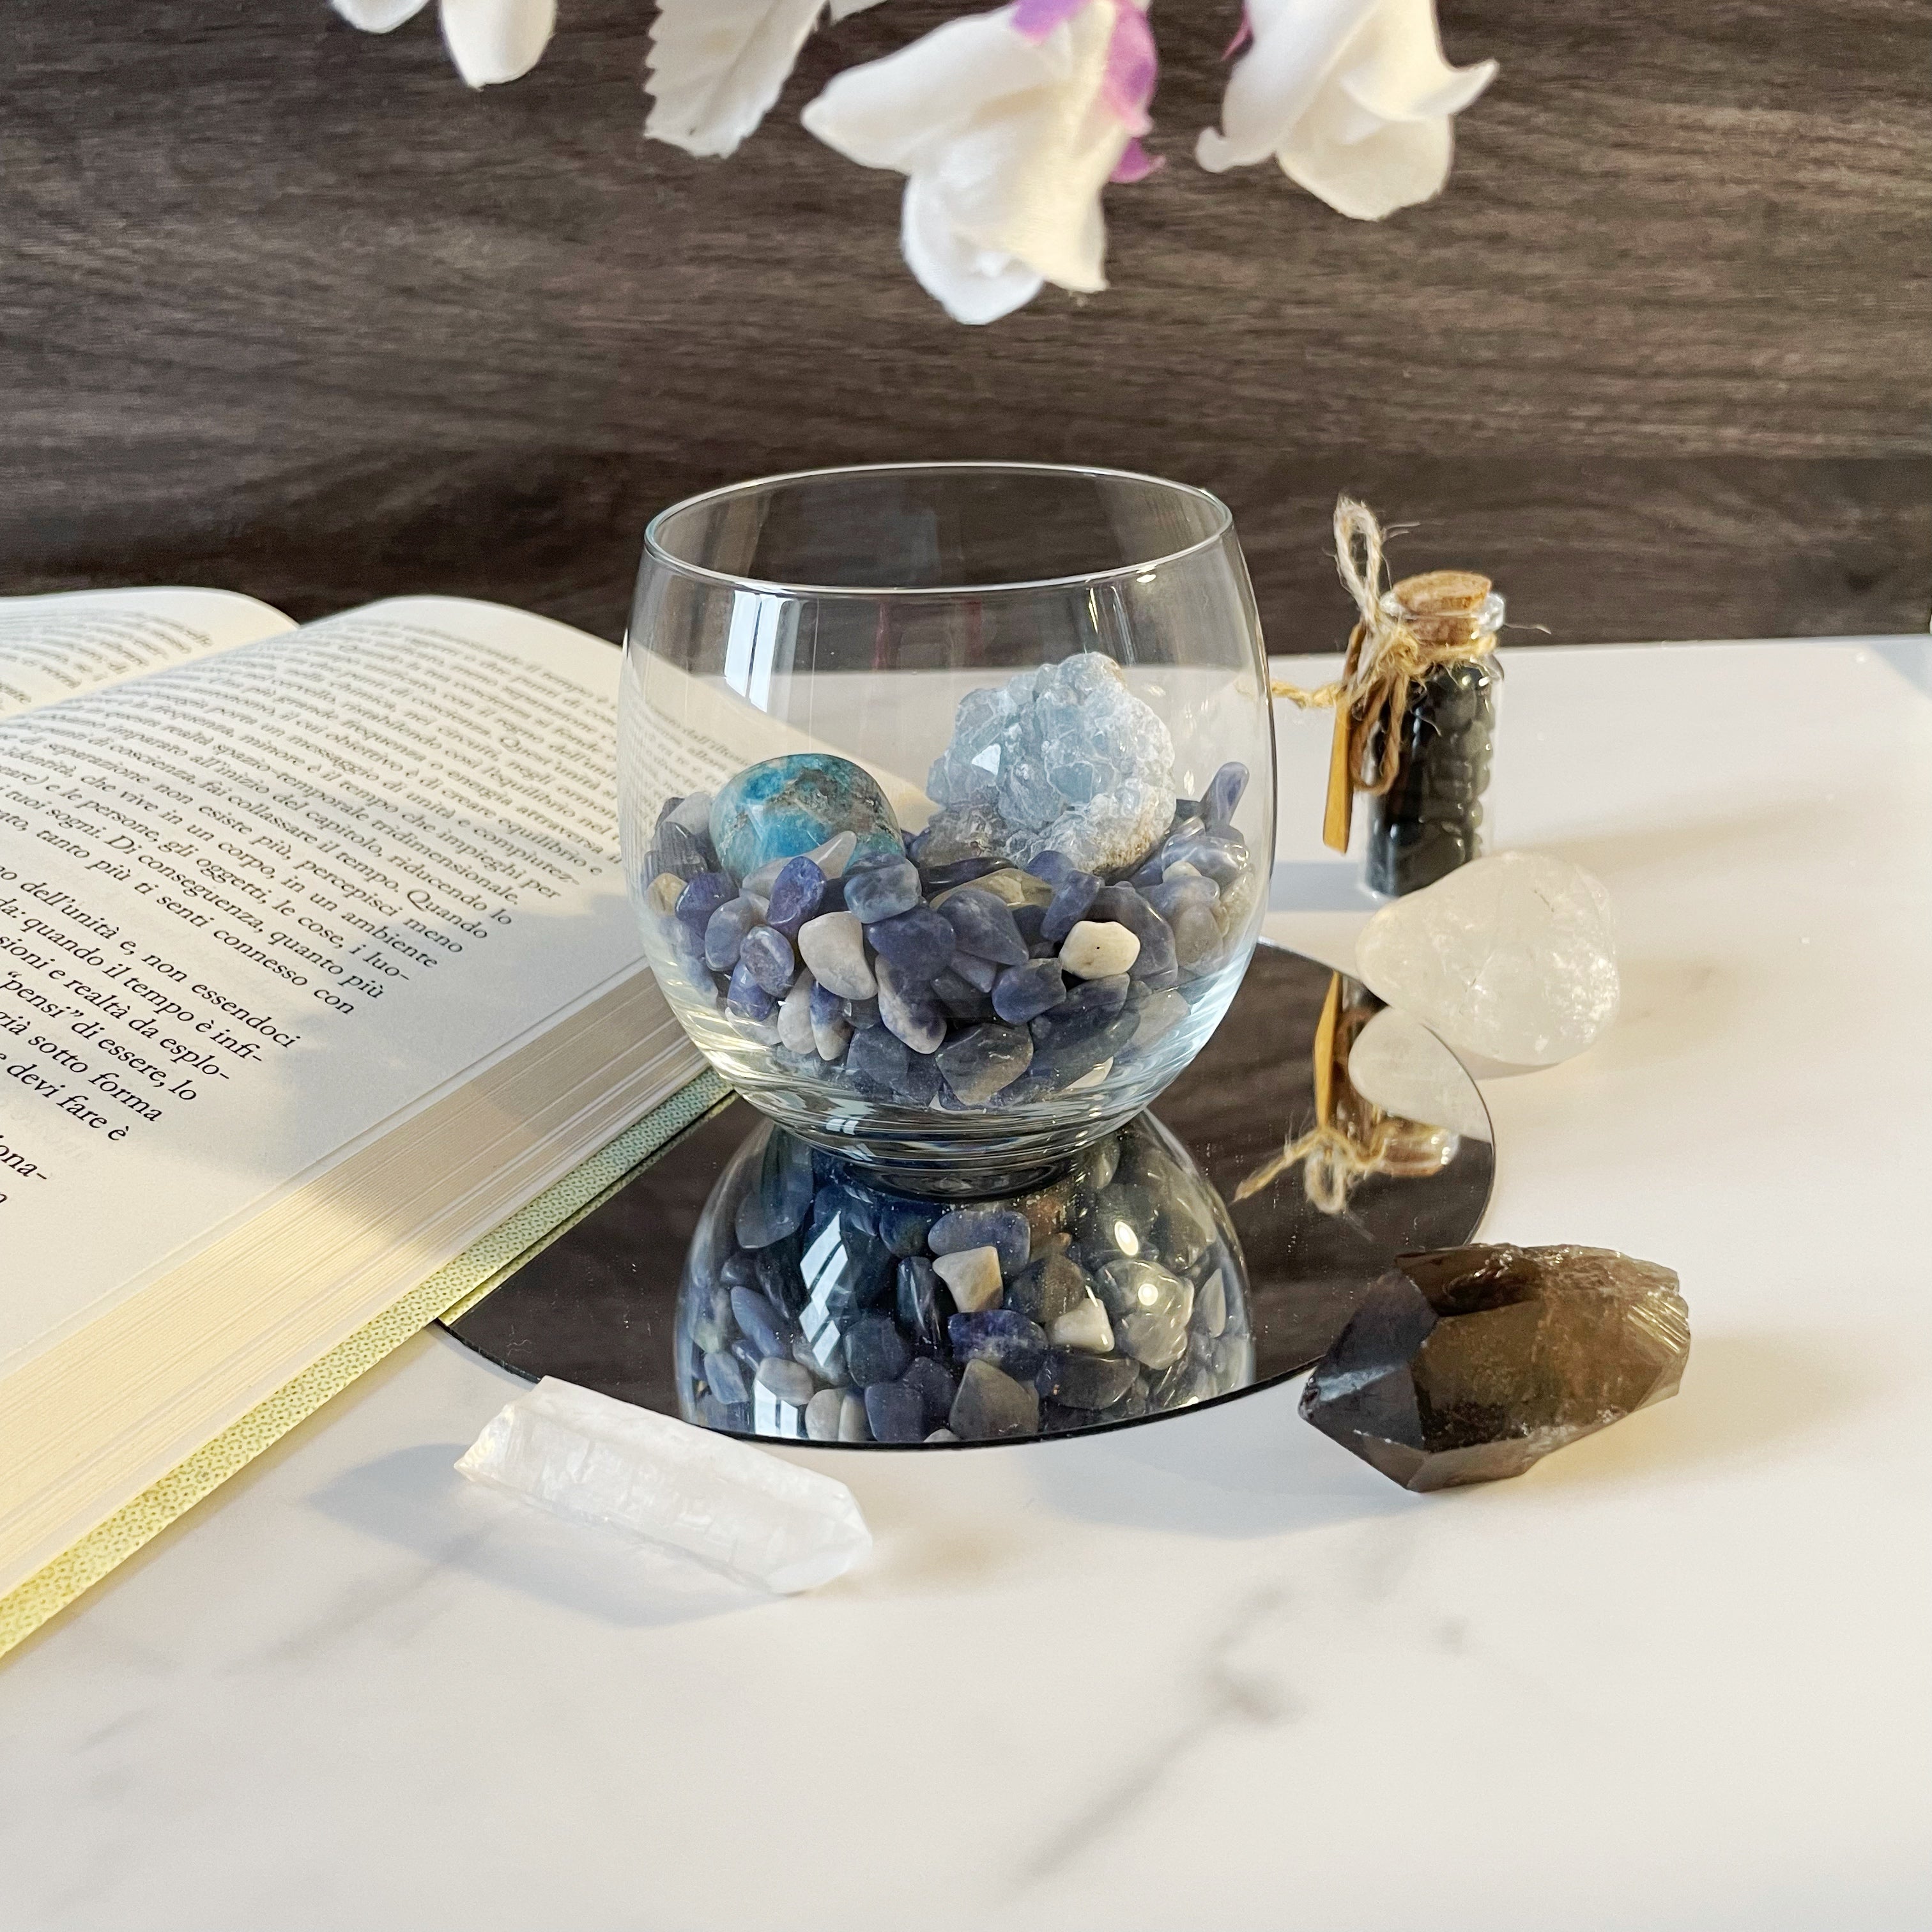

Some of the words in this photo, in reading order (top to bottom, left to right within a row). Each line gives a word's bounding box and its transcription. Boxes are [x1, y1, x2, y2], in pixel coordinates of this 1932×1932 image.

[43, 743, 151, 785] separazione
[153, 783, 194, 805] non
[198, 806, 252, 834] esiste
[249, 836, 291, 861] più,
[293, 860, 403, 917] percepisci
[403, 918, 463, 953] meno
[109, 737, 196, 785] coscienza,
[199, 781, 233, 797] fai
[227, 795, 323, 844] collassare
[316, 840, 341, 854] il
[335, 852, 399, 893] tempo.
[406, 890, 488, 939] Quando
[189, 756, 270, 794] all'inizio
[272, 793, 310, 811] del
[305, 811, 383, 857] capitolo,
[387, 855, 487, 911] riducendo
[490, 908, 512, 925] lo
[212, 744, 370, 822] spazio-temporale
[371, 819, 518, 905] tridimensionale.
[238, 735, 305, 766] minore
[320, 770, 342, 782] il
[339, 780, 399, 813] tempo
[401, 813, 436, 832] che
[437, 829, 526, 880] impieghi
[519, 879, 561, 898] per
[287, 735, 379, 781] messaggio
[382, 781, 407, 793] di
[406, 792, 456, 820] unità
[457, 819, 471, 827] e
[325, 733, 404, 772] obiettivo
[418, 777, 443, 790] di
[441, 790, 497, 818] creare
[498, 818, 587, 867] equilibrio
[4, 790, 52, 810] tuoi
[45, 806, 107, 839] sogni.
[103, 834, 142, 855] Di
[137, 855, 264, 933] conseguenza,
[268, 931, 344, 975] quanto
[337, 975, 384, 999] più
[36, 830, 90, 858] tanto
[84, 860, 131, 882] più
[134, 882, 159, 895] ti
[156, 892, 215, 928] senti
[213, 930, 308, 986] connesso
[313, 989, 355, 1015] con
[59, 788, 82, 801] le
[75, 800, 160, 842] persone,
[157, 841, 199, 857] gli
[195, 858, 272, 904] oggetti,
[272, 899, 296, 916] le
[298, 917, 344, 949] cose,
[349, 944, 367, 955] i
[362, 951, 410, 981] luo-
[80, 776, 117, 792] che
[119, 791, 159, 811] vive
[158, 809, 183, 825] in
[187, 824, 215, 842] un
[217, 843, 275, 879] corpo,
[280, 875, 305, 894] in
[309, 893, 338, 912] un
[341, 914, 438, 968] ambiente
[0, 971, 84, 1018] “pensi”
[71, 1022, 105, 1040] di
[98, 1039, 167, 1087] essere,
[167, 1079, 197, 1100] lo
[20, 882, 119, 940] dell'unità
[119, 941, 137, 956] e,
[141, 954, 188, 983] non
[191, 984, 301, 1048] essendoci
[20, 918, 104, 966] quando
[102, 963, 132, 979] il
[123, 977, 195, 1022] tempo
[195, 1019, 214, 1032] è
[209, 1029, 262, 1062] infi-
[48, 970, 66, 979] e
[63, 979, 131, 1020] realtà
[128, 1018, 159, 1039] da
[159, 1038, 229, 1080] esplo-
[6, 1064, 66, 1098] devi
[56, 1095, 107, 1129] fare
[107, 1125, 129, 1141] è
[27, 1036, 88, 1073] sotto
[88, 1073, 162, 1122] forma
